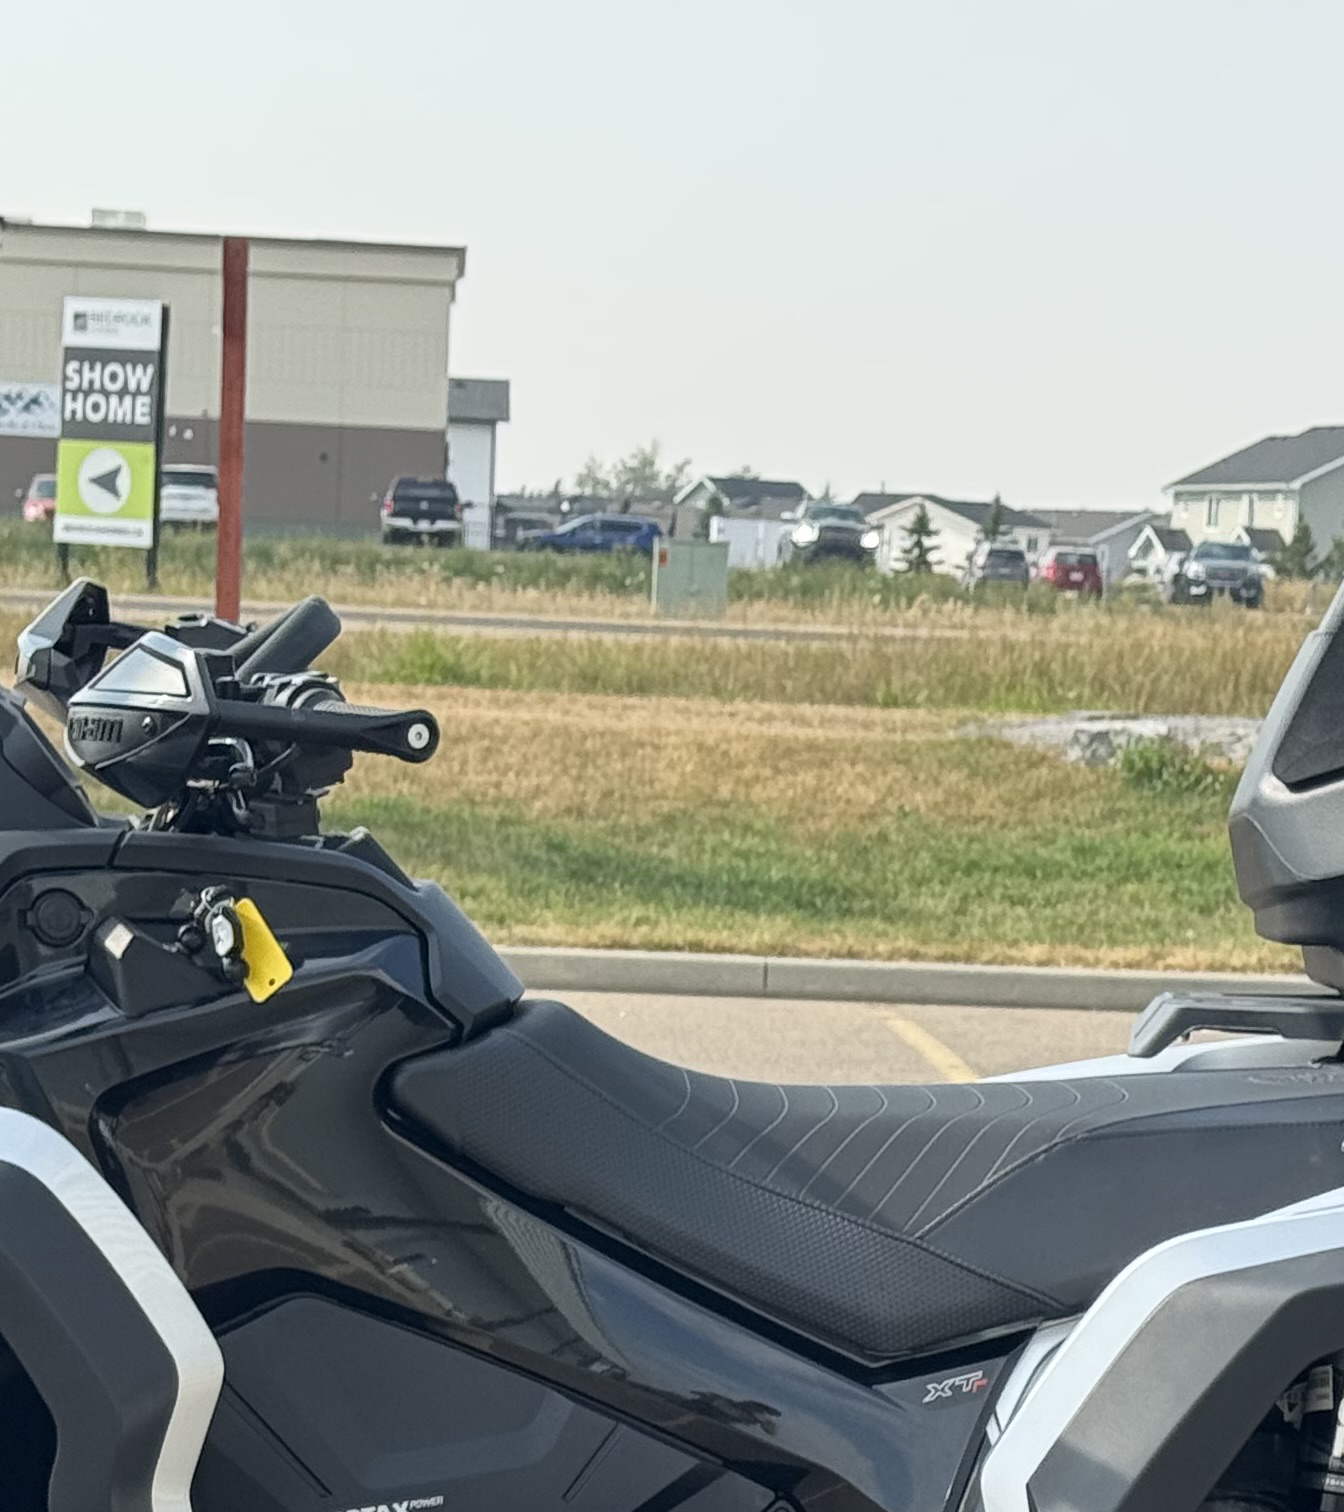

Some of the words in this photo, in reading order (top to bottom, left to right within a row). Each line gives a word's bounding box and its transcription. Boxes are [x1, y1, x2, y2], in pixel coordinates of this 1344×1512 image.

[64, 360, 155, 393] SHOW
[64, 392, 153, 425] HOME
[409, 1495, 444, 1511] POWER
